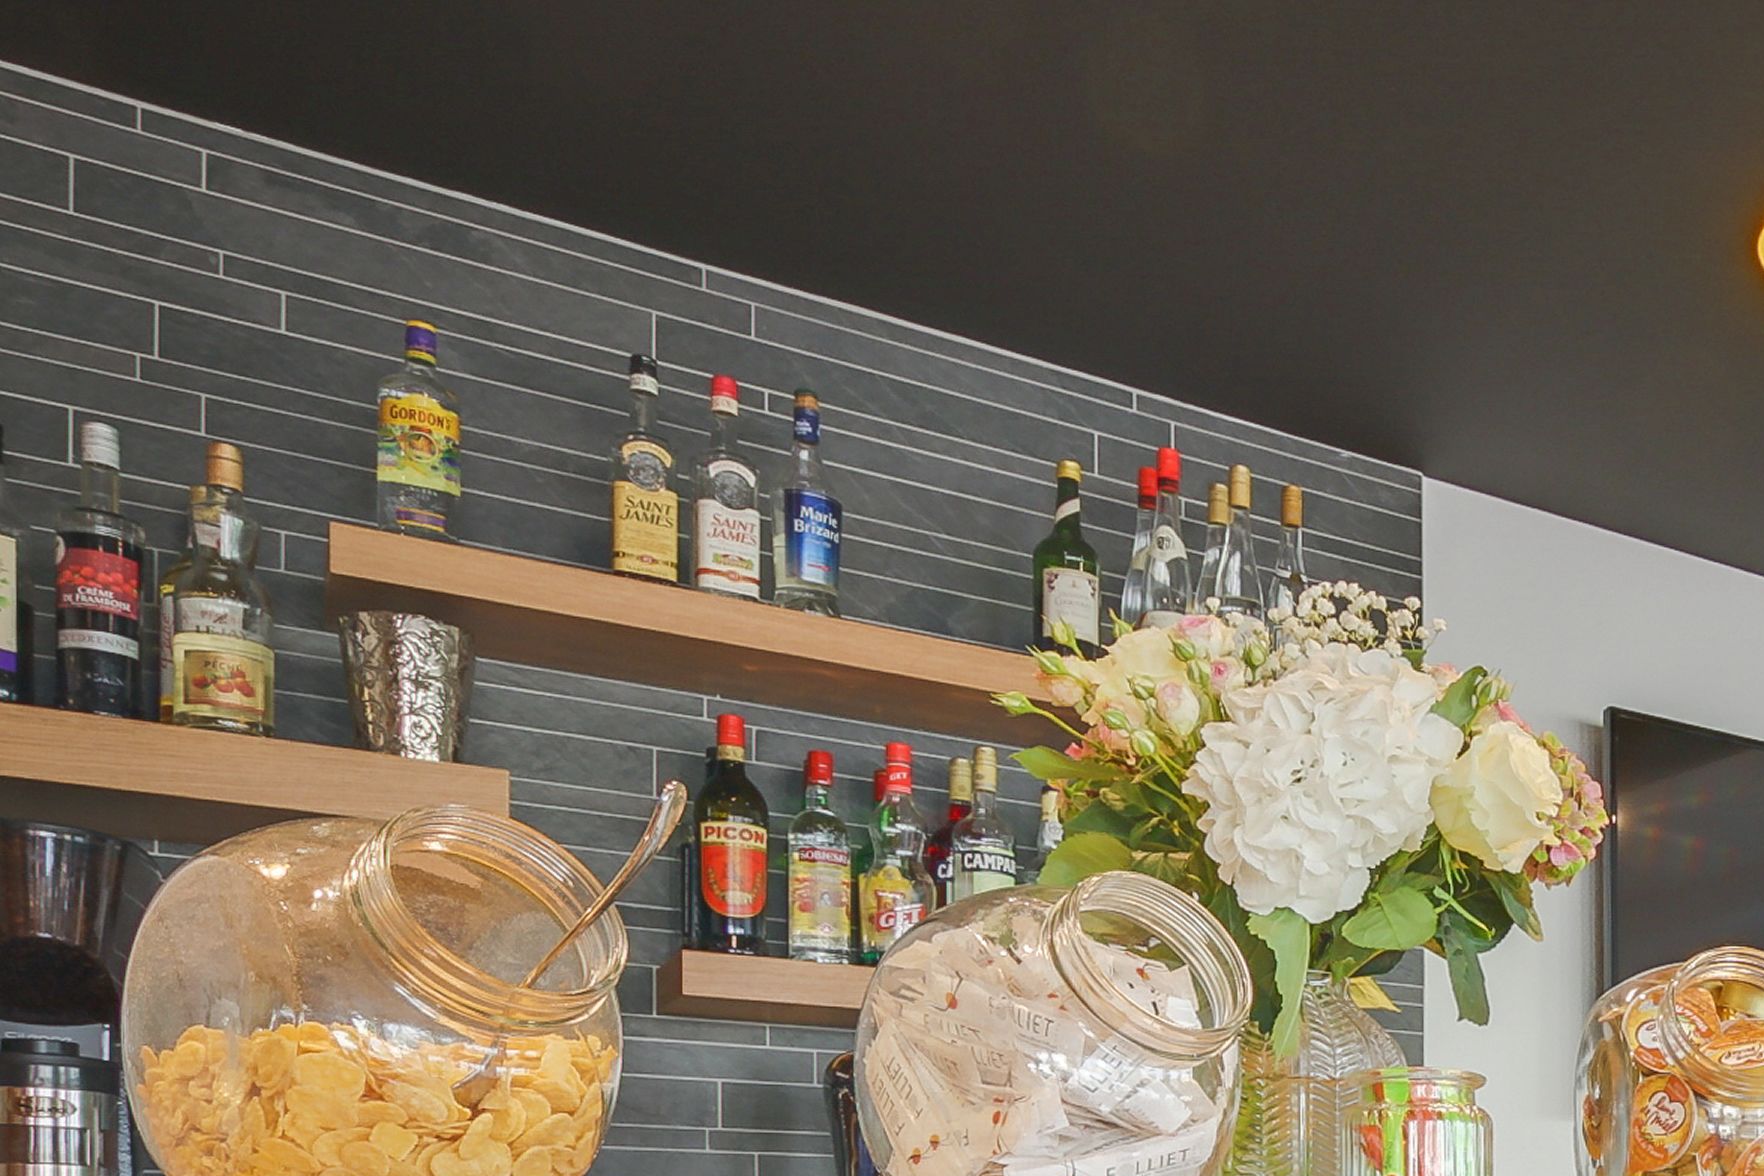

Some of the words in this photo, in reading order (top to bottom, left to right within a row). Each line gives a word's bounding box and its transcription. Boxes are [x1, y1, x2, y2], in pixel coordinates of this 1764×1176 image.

[390, 404, 451, 430] GORDON'S
[625, 495, 673, 515] SAINT
[620, 509, 674, 528] JAMES
[712, 513, 757, 532] SAINT
[800, 505, 838, 528] Marie
[707, 528, 757, 546] JAMES
[793, 519, 840, 543] Brizard
[75, 593, 132, 613] FRAMBOISE
[704, 825, 765, 844] PICON
